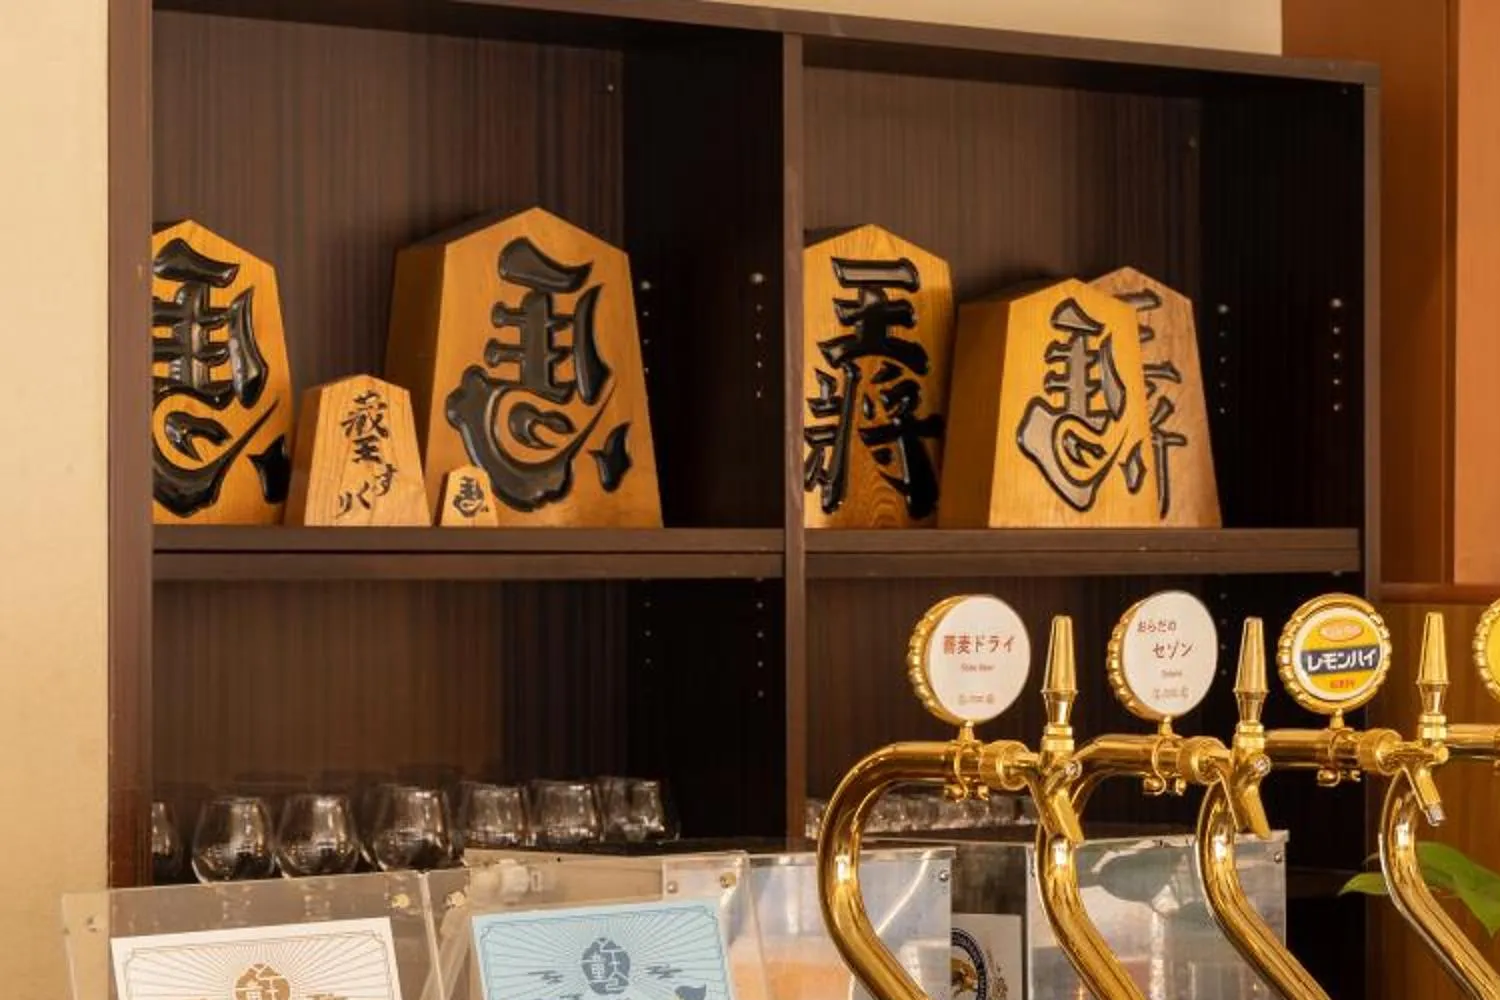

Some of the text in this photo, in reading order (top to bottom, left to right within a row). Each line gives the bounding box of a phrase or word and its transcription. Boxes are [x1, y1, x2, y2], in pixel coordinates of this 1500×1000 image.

[1138, 620, 1177, 634] おらだの
[943, 633, 1016, 655] 蕎麦ドライ
[1152, 640, 1194, 660] セゾン
[1306, 647, 1377, 672] レモンハイ
